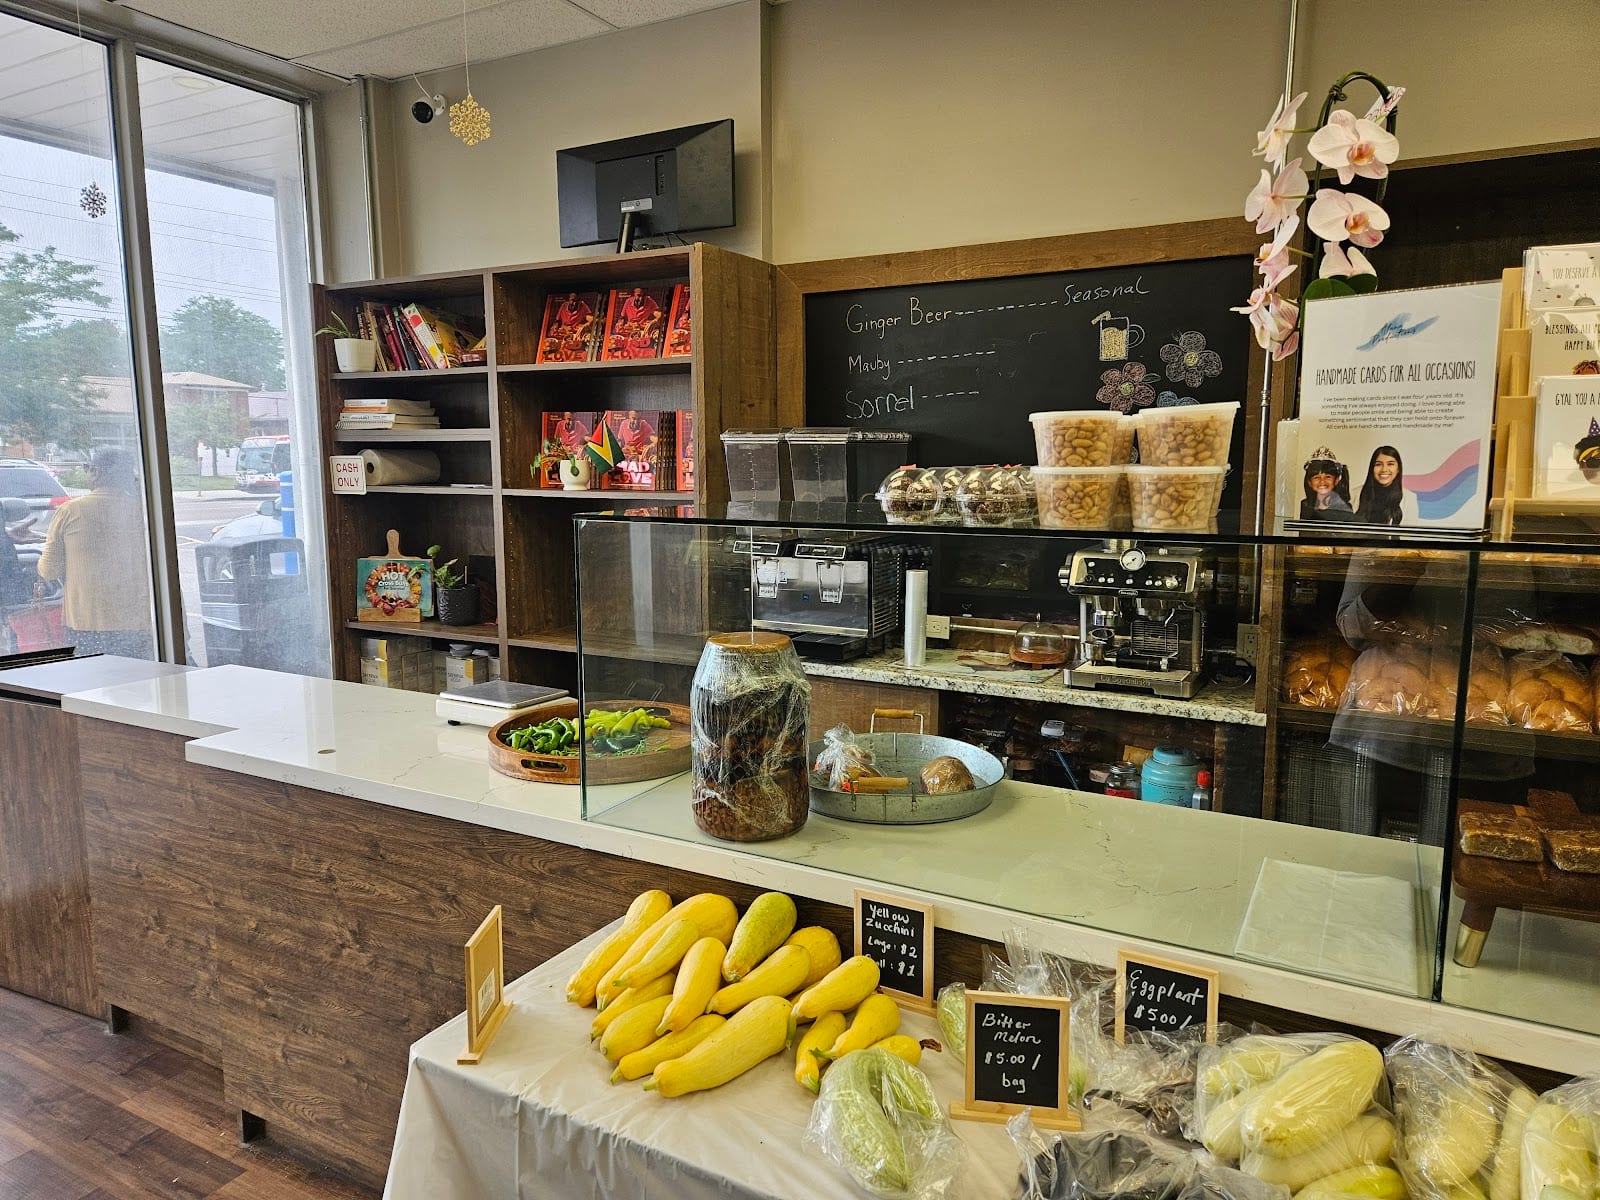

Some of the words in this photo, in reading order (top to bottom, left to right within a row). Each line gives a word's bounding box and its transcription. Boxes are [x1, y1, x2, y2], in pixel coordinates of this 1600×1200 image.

[846, 304, 902, 339] Ginger
[909, 297, 952, 326] Beer
[1064, 275, 1151, 306] Seasonal
[1545, 323, 1578, 335] BLESSINGS
[1564, 340, 1584, 352] HAPPY
[848, 354, 891, 381] Mauby
[1316, 366, 1357, 385] HANDMADE
[1360, 365, 1387, 384] CARDS
[1389, 364, 1404, 382] FOR
[1407, 363, 1421, 381] ALL
[1425, 360, 1476, 381] OCCASIONS!
[846, 385, 915, 419] Sorrel
[1555, 392, 1573, 406] GYAL
[1575, 392, 1588, 406] YOU
[1590, 392, 1596, 406] A
[335, 463, 359, 473] CASH
[337, 477, 360, 487] ONLY
[869, 904, 910, 924] Yellow
[865, 917, 915, 938] Zucchini
[1130, 969, 1204, 1006] Eggplant
[982, 1012, 1031, 1030] Bitter
[993, 1031, 1042, 1044] Melon
[1002, 1072, 1026, 1094] bag
